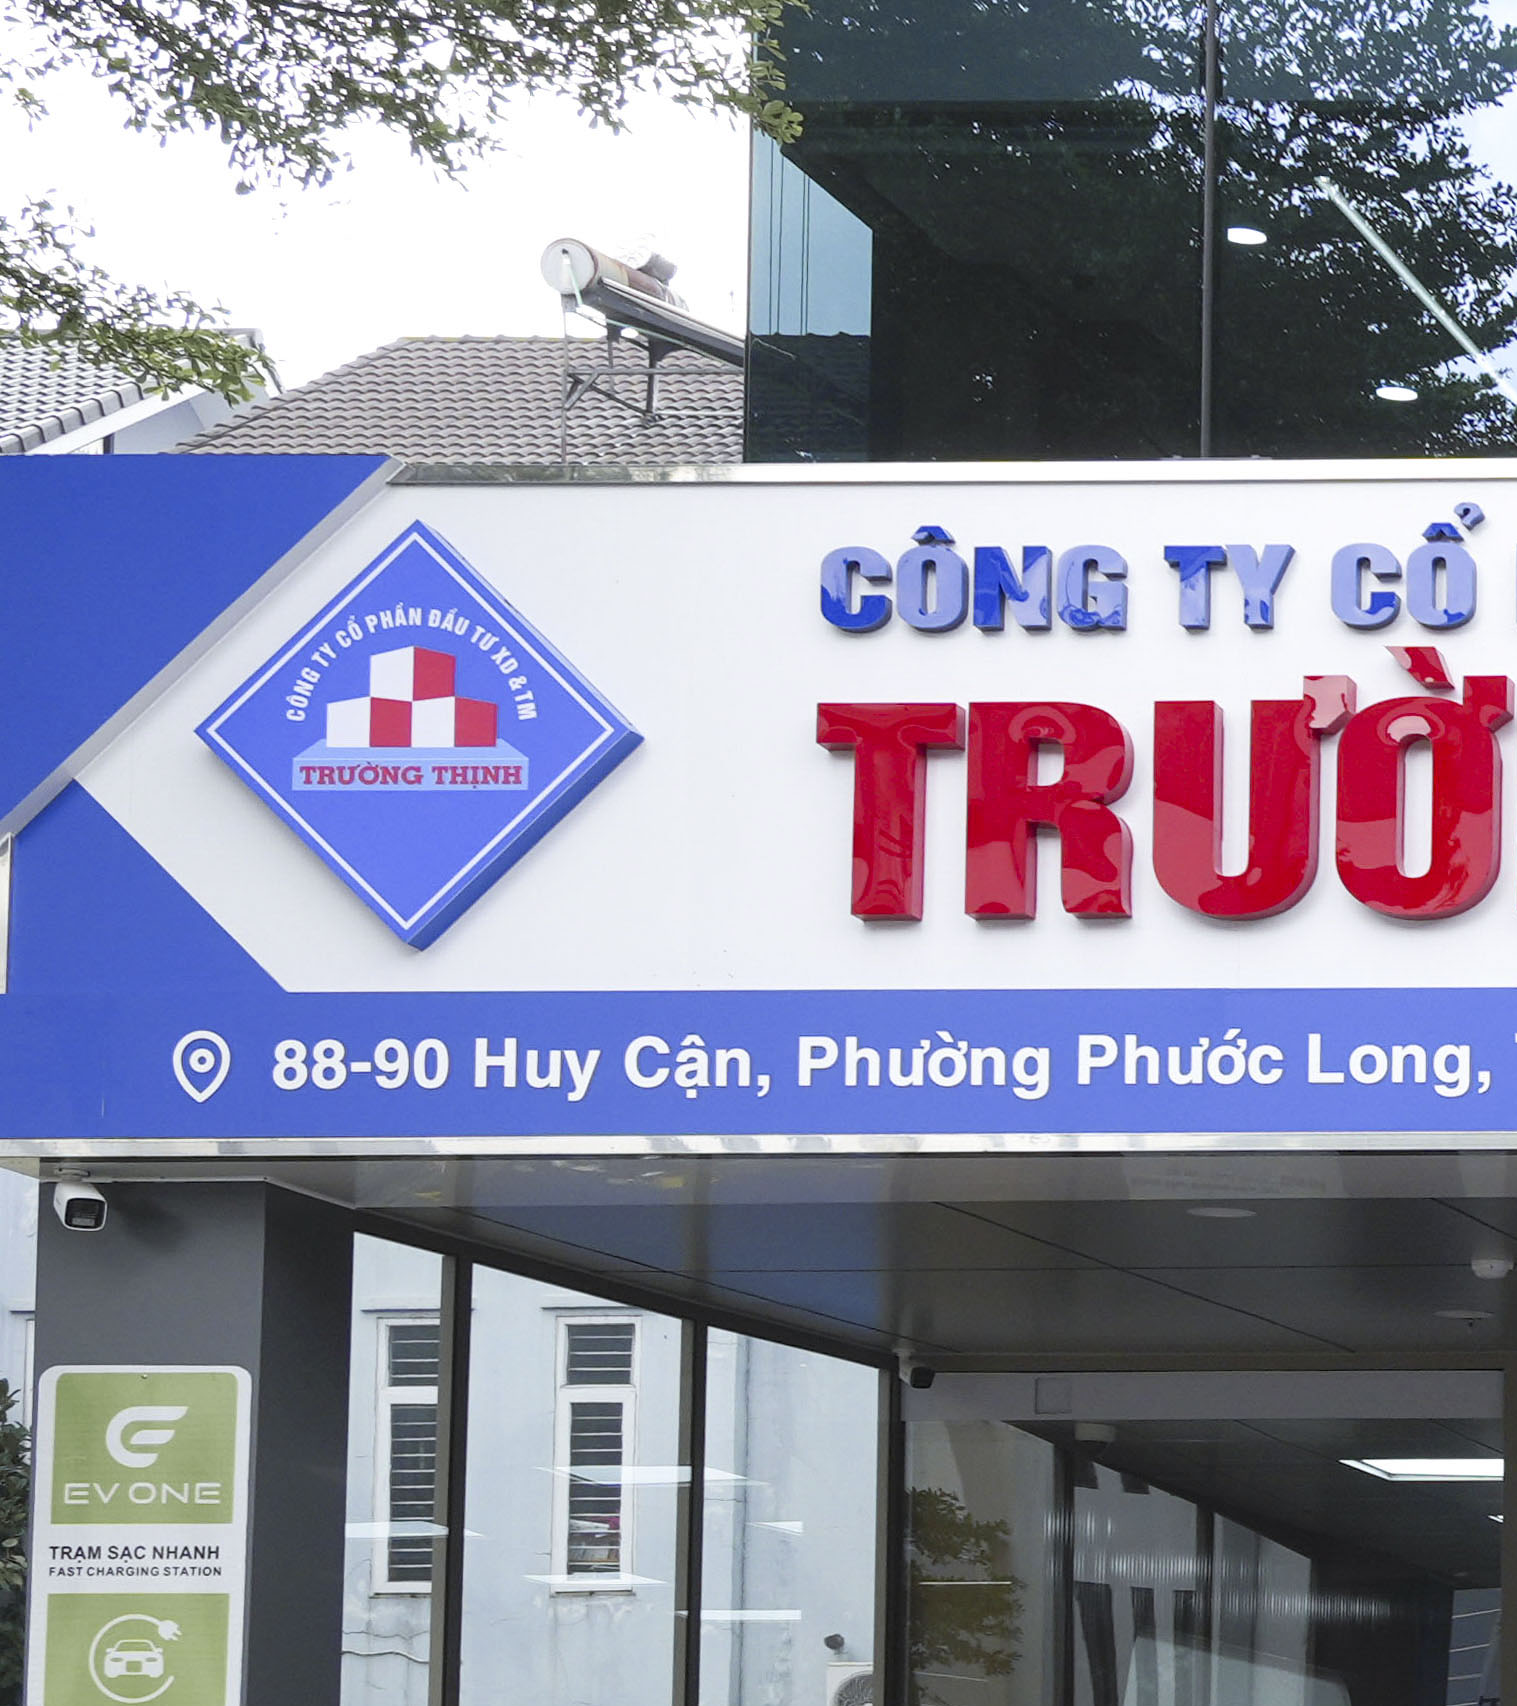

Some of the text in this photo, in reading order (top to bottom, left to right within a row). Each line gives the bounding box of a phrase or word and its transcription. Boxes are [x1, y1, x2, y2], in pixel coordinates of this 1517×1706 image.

[820, 526, 1128, 632] CÔNG
[1164, 545, 1296, 630] TY
[1331, 503, 1485, 627] CỔ
[470, 626, 500, 651] TƯ
[311, 643, 337, 668] TY
[491, 646, 520, 675] XD
[286, 667, 321, 722] CÔNG
[508, 675, 527, 691] &
[514, 690, 538, 721] TM
[299, 761, 523, 789] TRƯỜNG THỊNH
[274, 1039, 448, 1089] 88-90
[476, 1038, 600, 1100] Huy
[625, 1035, 769, 1098] Cận,
[799, 1032, 1049, 1099] Phường
[1078, 1029, 1282, 1084] Phước
[1309, 1034, 1490, 1096] Long,
[63, 1481, 221, 1505] EV ONE
[49, 1544, 220, 1565] TRẠM SẠC NHANH
[48, 1566, 222, 1578] FAST CHARGING STATION
